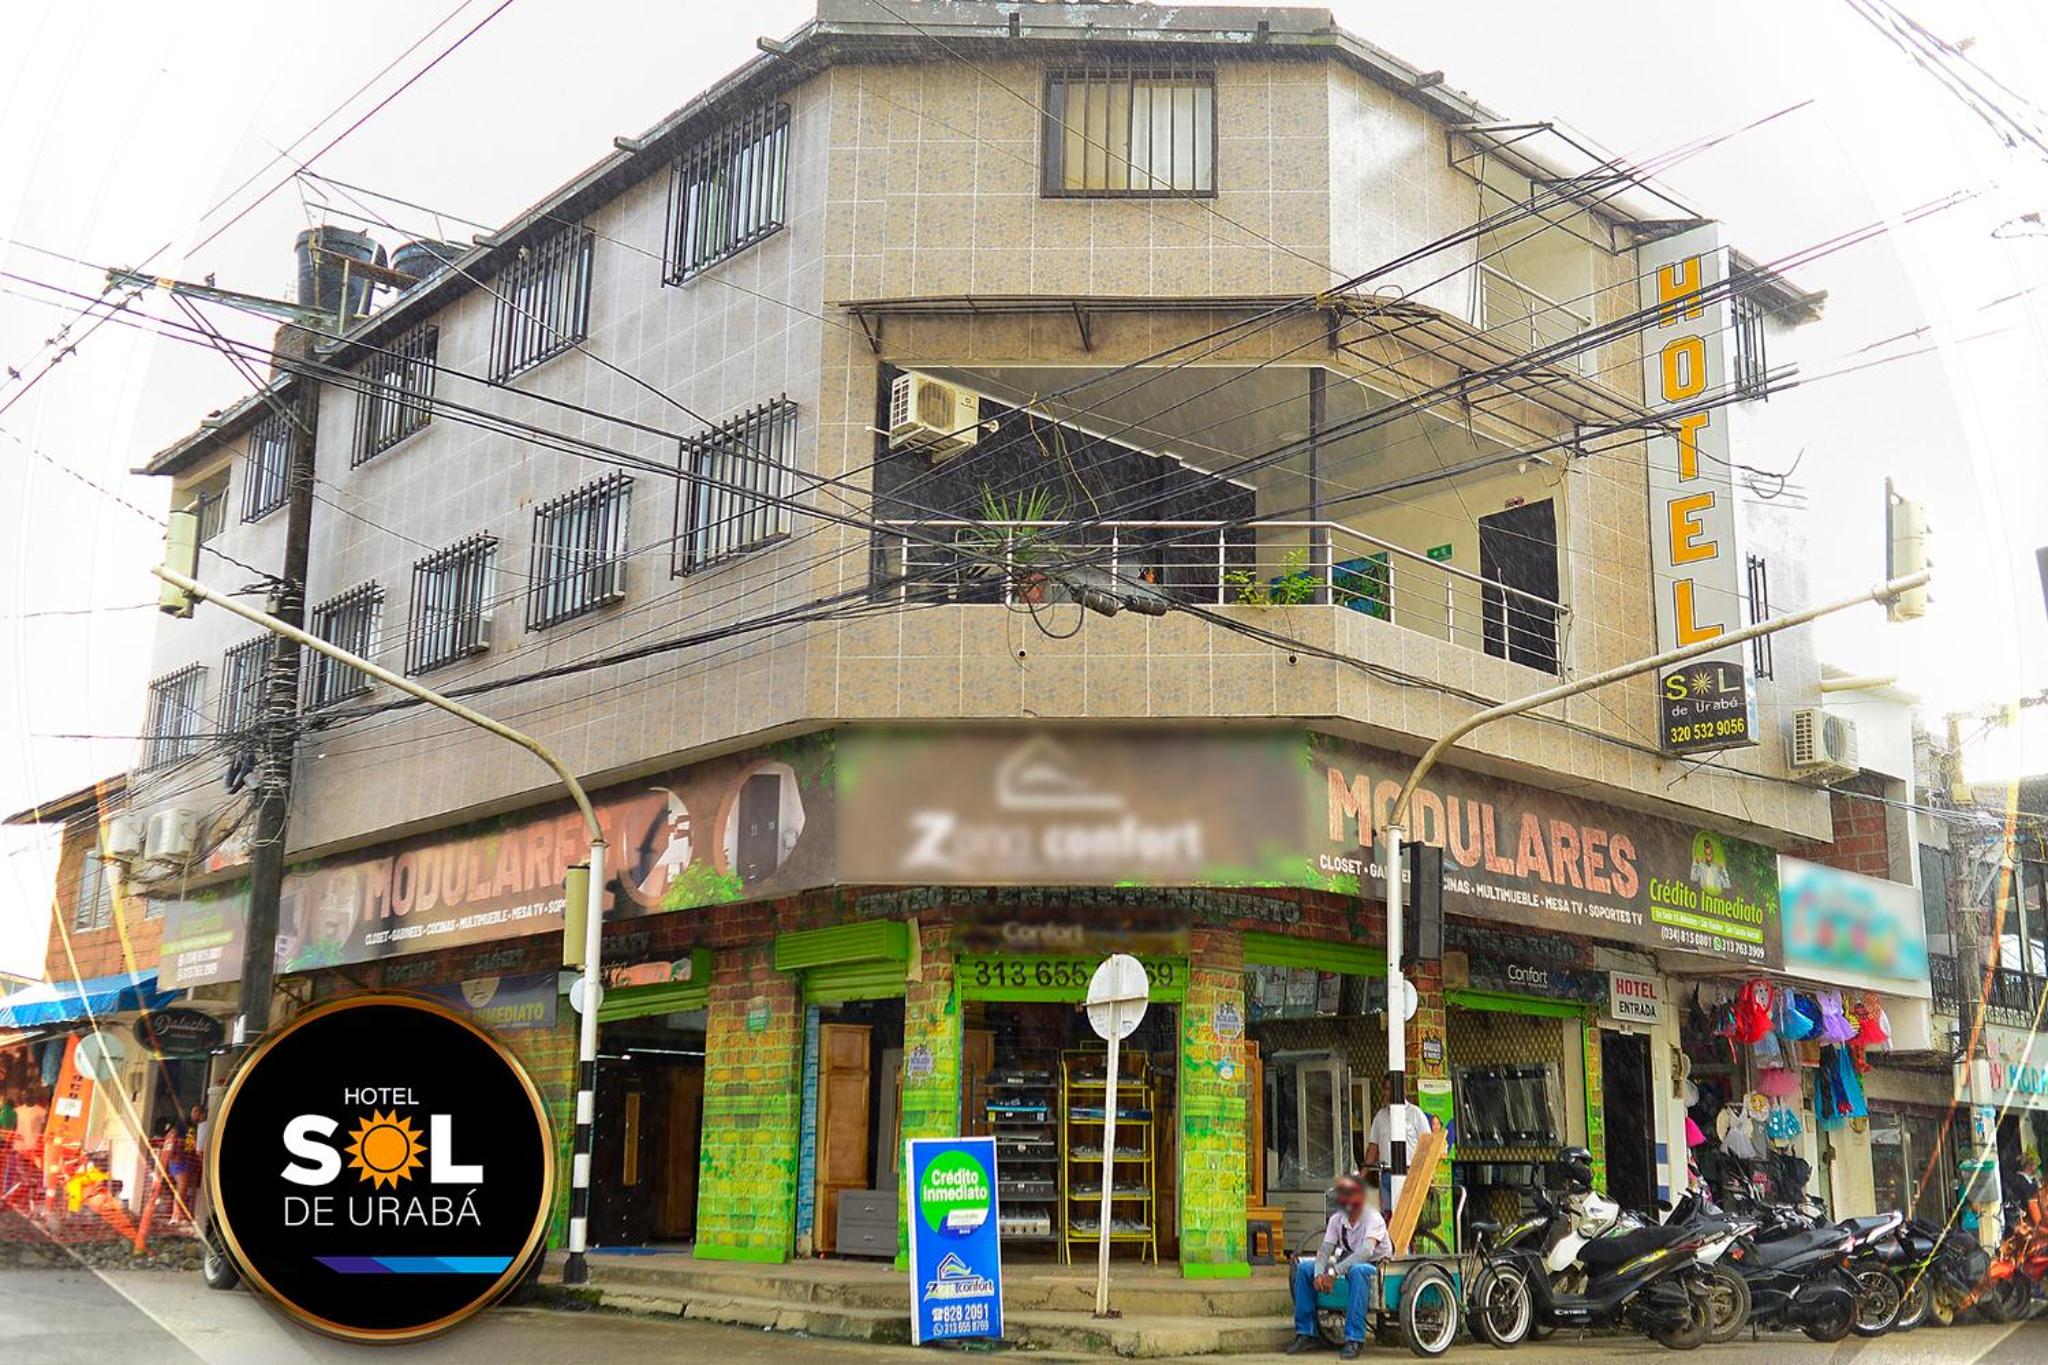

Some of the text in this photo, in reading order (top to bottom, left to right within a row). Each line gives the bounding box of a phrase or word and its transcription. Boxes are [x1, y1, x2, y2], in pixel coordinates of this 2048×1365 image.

[1656, 255, 1724, 648] HOTEL
[1671, 705, 1688, 717] de
[1671, 718, 1745, 743] 320 532 9056
[1327, 768, 1639, 899] MODULARES
[1320, 854, 1362, 875] CLOSET
[1477, 883, 1539, 907] MULTIMUEBLE
[1545, 897, 1570, 913] MESA
[1570, 902, 1583, 915] TV
[1589, 904, 1631, 924] SOPORTES
[1631, 911, 1643, 926] TV
[1649, 878, 1697, 909] Crédito
[1701, 891, 1764, 925] Inmediato
[1680, 929, 1694, 945] 815
[974, 961, 1026, 987] 313
[1036, 960, 1089, 987] 655
[1507, 964, 1548, 984] Confort
[1616, 978, 1657, 999] HOTEL
[1619, 1001, 1657, 1018] ENTRADA
[944, 1303, 988, 1322] 828 2091
